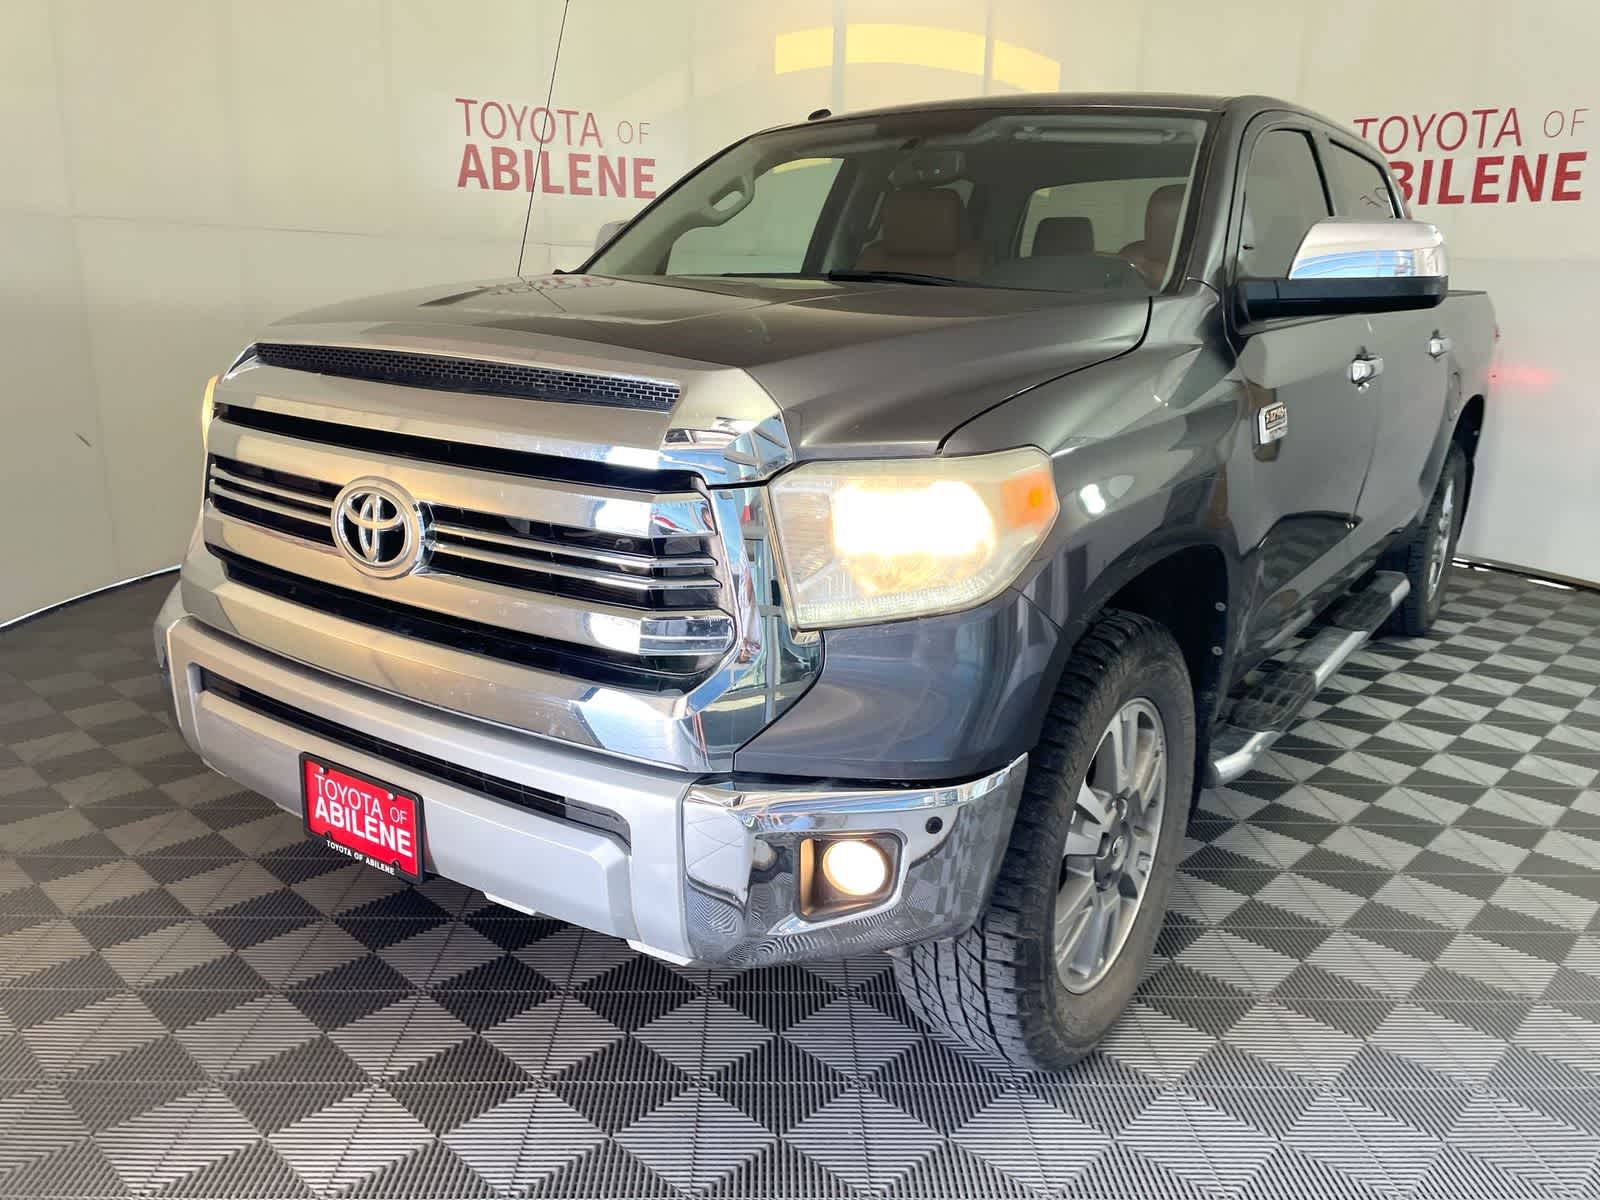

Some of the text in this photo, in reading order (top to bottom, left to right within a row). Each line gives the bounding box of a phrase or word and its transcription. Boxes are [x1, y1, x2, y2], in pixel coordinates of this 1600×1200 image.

[455, 97, 651, 148] TOYOTA OF
[1353, 107, 1589, 154] TOYOTA OF
[457, 143, 657, 199] ABILENE
[1386, 151, 1588, 205] BILENE
[314, 773, 407, 824] TOYOTA OF
[315, 796, 413, 858] ABILENE
[326, 840, 395, 875] TOYOTA OF ABILENE
